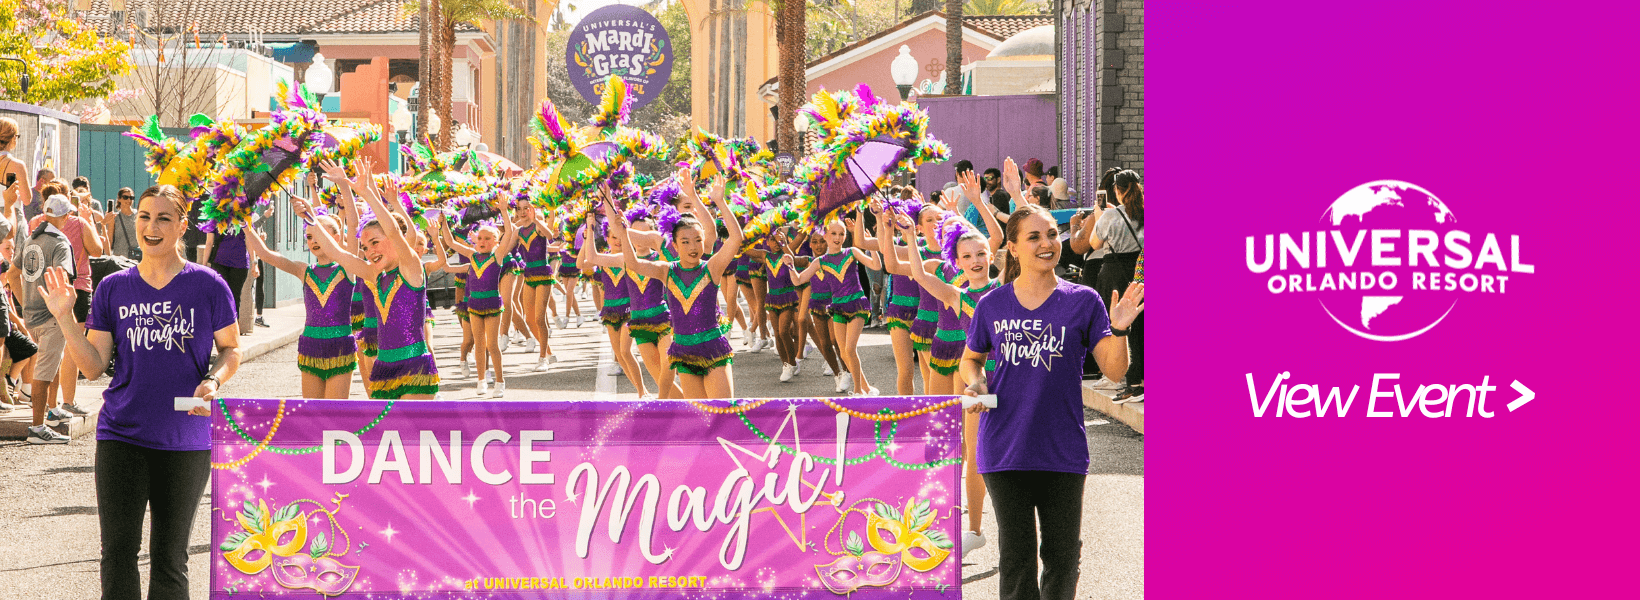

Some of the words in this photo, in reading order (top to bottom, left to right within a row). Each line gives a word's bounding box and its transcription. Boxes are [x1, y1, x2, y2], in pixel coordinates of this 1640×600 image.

[583, 20, 655, 31] UNIVERSAL'S
[118, 301, 172, 320] DANCE
[126, 308, 195, 352] Magic!
[135, 316, 154, 327] the
[993, 319, 1043, 334] DANCE
[1004, 331, 1023, 342] the
[1000, 326, 1066, 367] Magic!
[322, 430, 555, 485] DANCE
[565, 412, 850, 571] Magic!
[509, 492, 556, 519] the
[464, 577, 479, 589] at
[484, 577, 569, 589] UNIVERSAL
[573, 576, 644, 589] ORLANDO
[649, 576, 707, 588] RESORT
